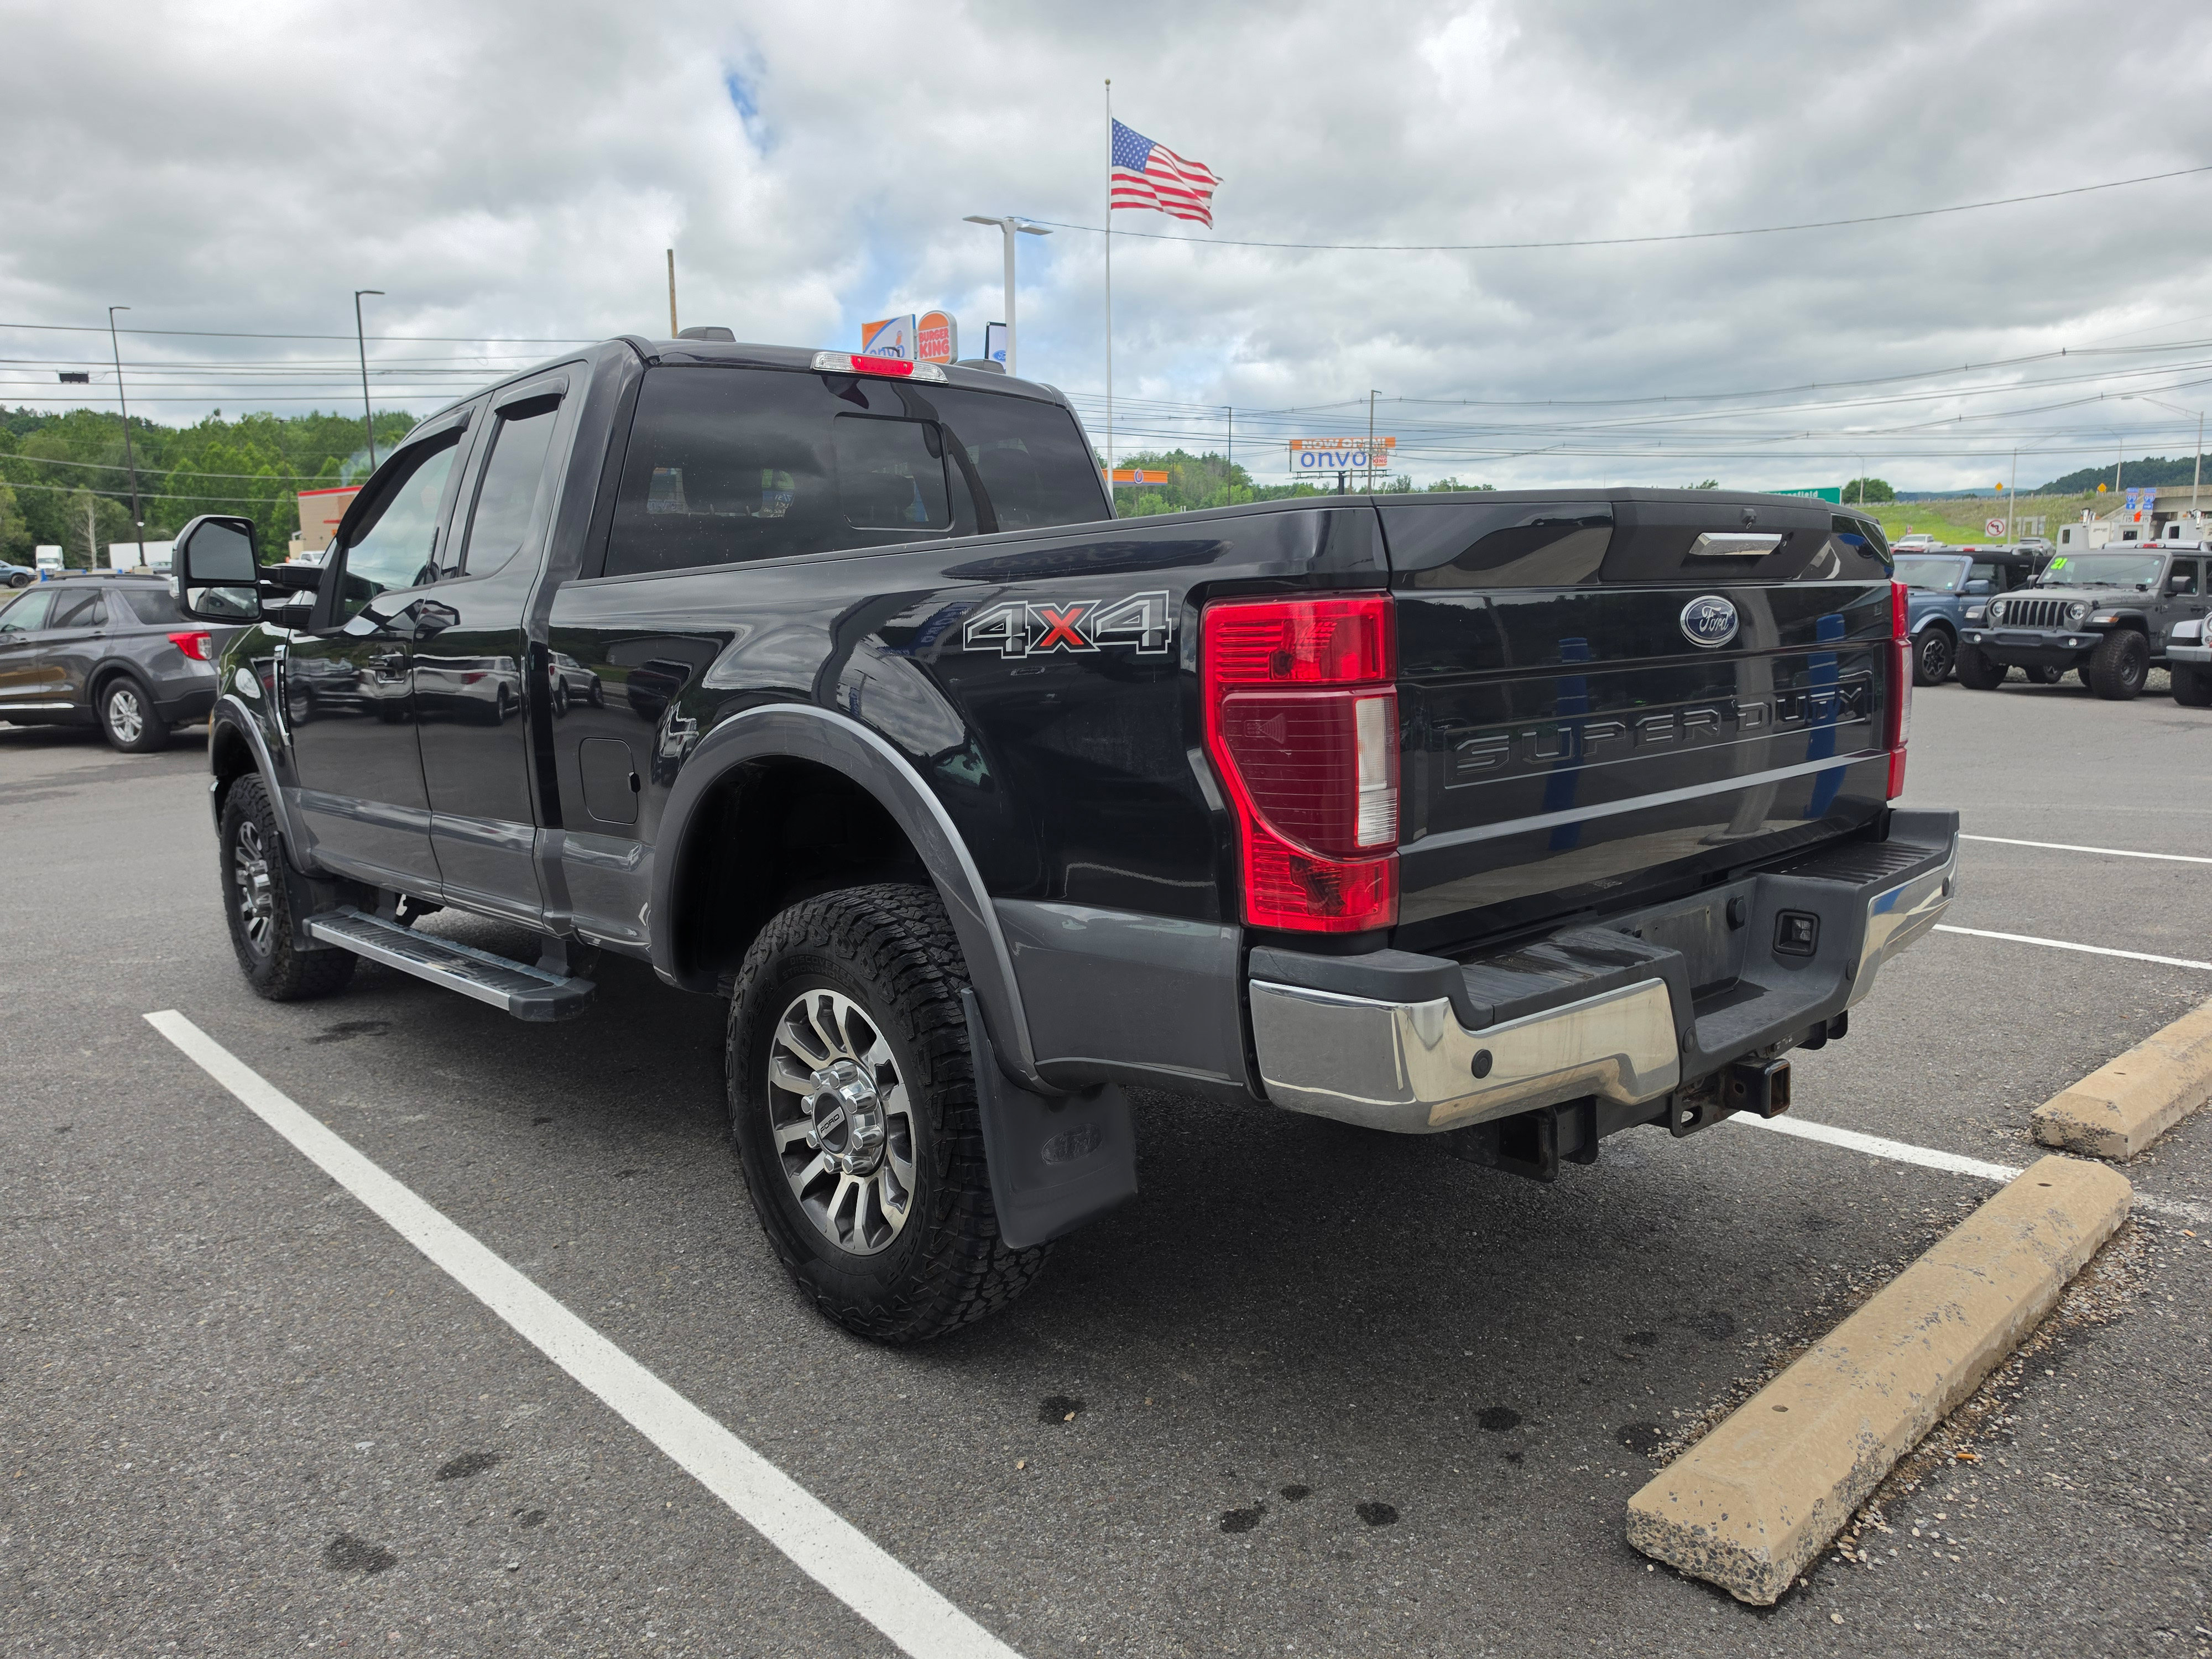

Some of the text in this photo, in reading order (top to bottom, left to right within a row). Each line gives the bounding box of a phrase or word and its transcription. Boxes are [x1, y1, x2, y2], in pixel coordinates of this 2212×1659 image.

[919, 328, 950, 343] BURGER
[920, 339, 950, 358] KING
[1302, 439, 1339, 449] NOW
[1301, 451, 1366, 468] onvo
[2051, 557, 2068, 570] 21
[1699, 606, 1729, 632] Ford
[1455, 687, 1863, 775] SUPER DUTY
[782, 964, 851, 987] STRONGHOLD
[790, 955, 854, 984] DISCOVERER
[821, 1114, 840, 1134] FORD
